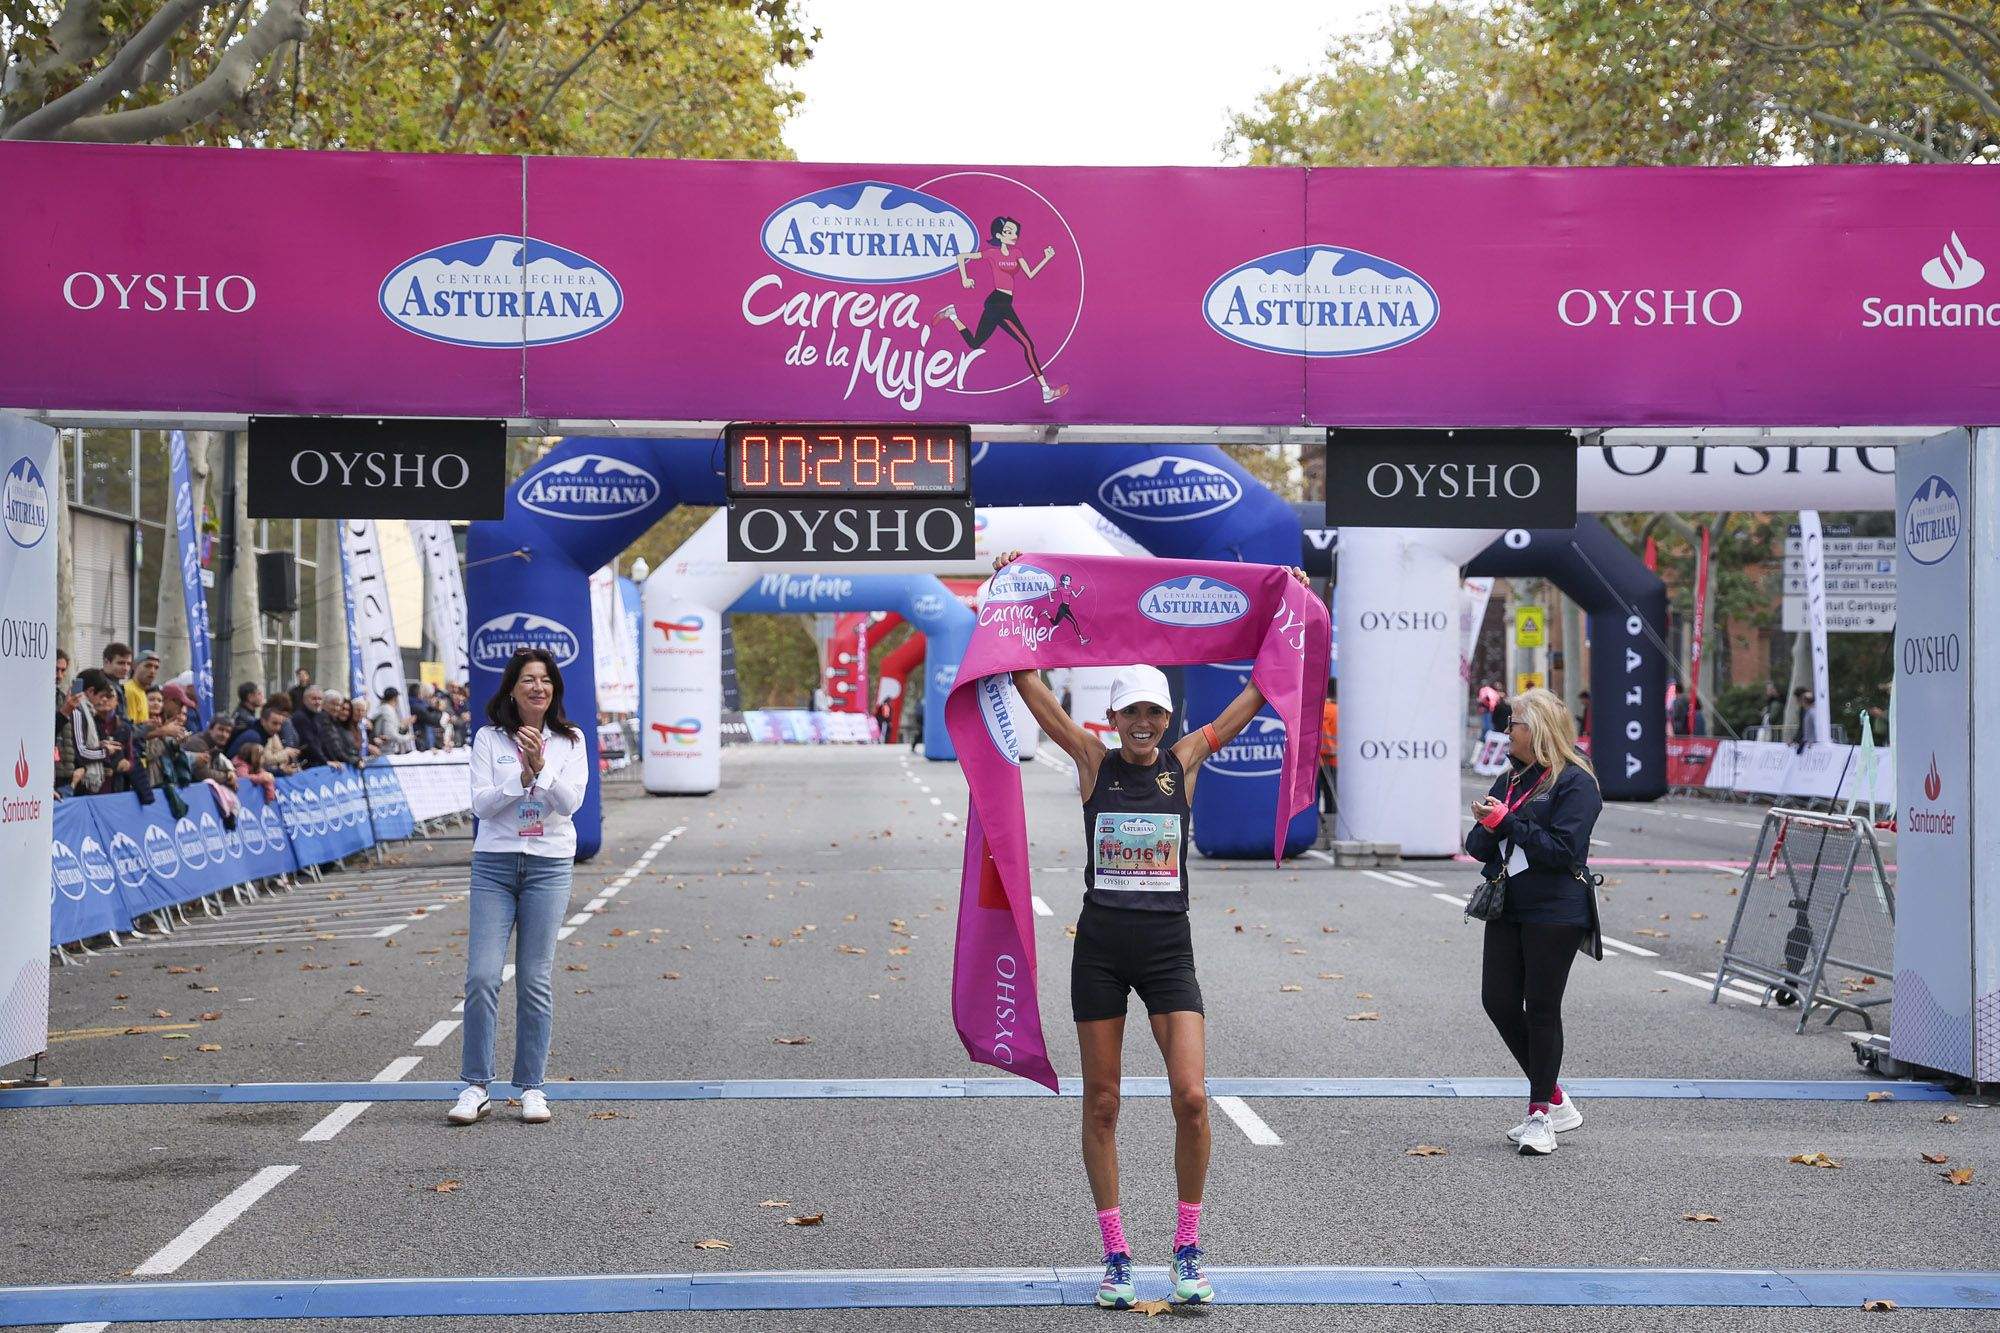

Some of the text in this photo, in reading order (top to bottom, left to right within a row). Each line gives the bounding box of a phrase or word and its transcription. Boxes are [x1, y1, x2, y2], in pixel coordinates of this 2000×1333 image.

[778, 218, 962, 257] ASTURIANA
[812, 216, 955, 227] CENTRAL LECHERA
[64, 272, 256, 313] OYSHO
[399, 276, 605, 318] ASTURIANA
[436, 274, 511, 285] CENTRAL
[1259, 284, 1414, 295] CENTRAL LECHERA
[742, 274, 921, 329] Carrera
[1221, 285, 1421, 327] ASTURIANA
[1558, 289, 1742, 327] OYSHO
[785, 324, 986, 411] de la Mujer
[290, 450, 469, 490] OYSHO
[742, 436, 955, 486] 00:28:24
[526, 479, 648, 504] ASTURIANA
[1111, 483, 1233, 508] ASTURIANA
[1367, 463, 1541, 499] OYSHO
[5, 487, 45, 528] ASTURIANA
[739, 508, 963, 553] OYSHO
[1907, 514, 1957, 545] ASTURIANA
[1147, 594, 1241, 614] ASTURIANA
[1360, 611, 1448, 631] OYSHO
[2, 617, 48, 660] OYSHO
[1904, 633, 1960, 675] OYSHO
[1625, 614, 1643, 779] VOLVO
[1207, 744, 1283, 762] STURIA
[1360, 740, 1448, 760] OYSHO
[3, 795, 41, 823] Santander
[1909, 806, 1956, 835] Santander
[993, 953, 1016, 1065] OYSHO
